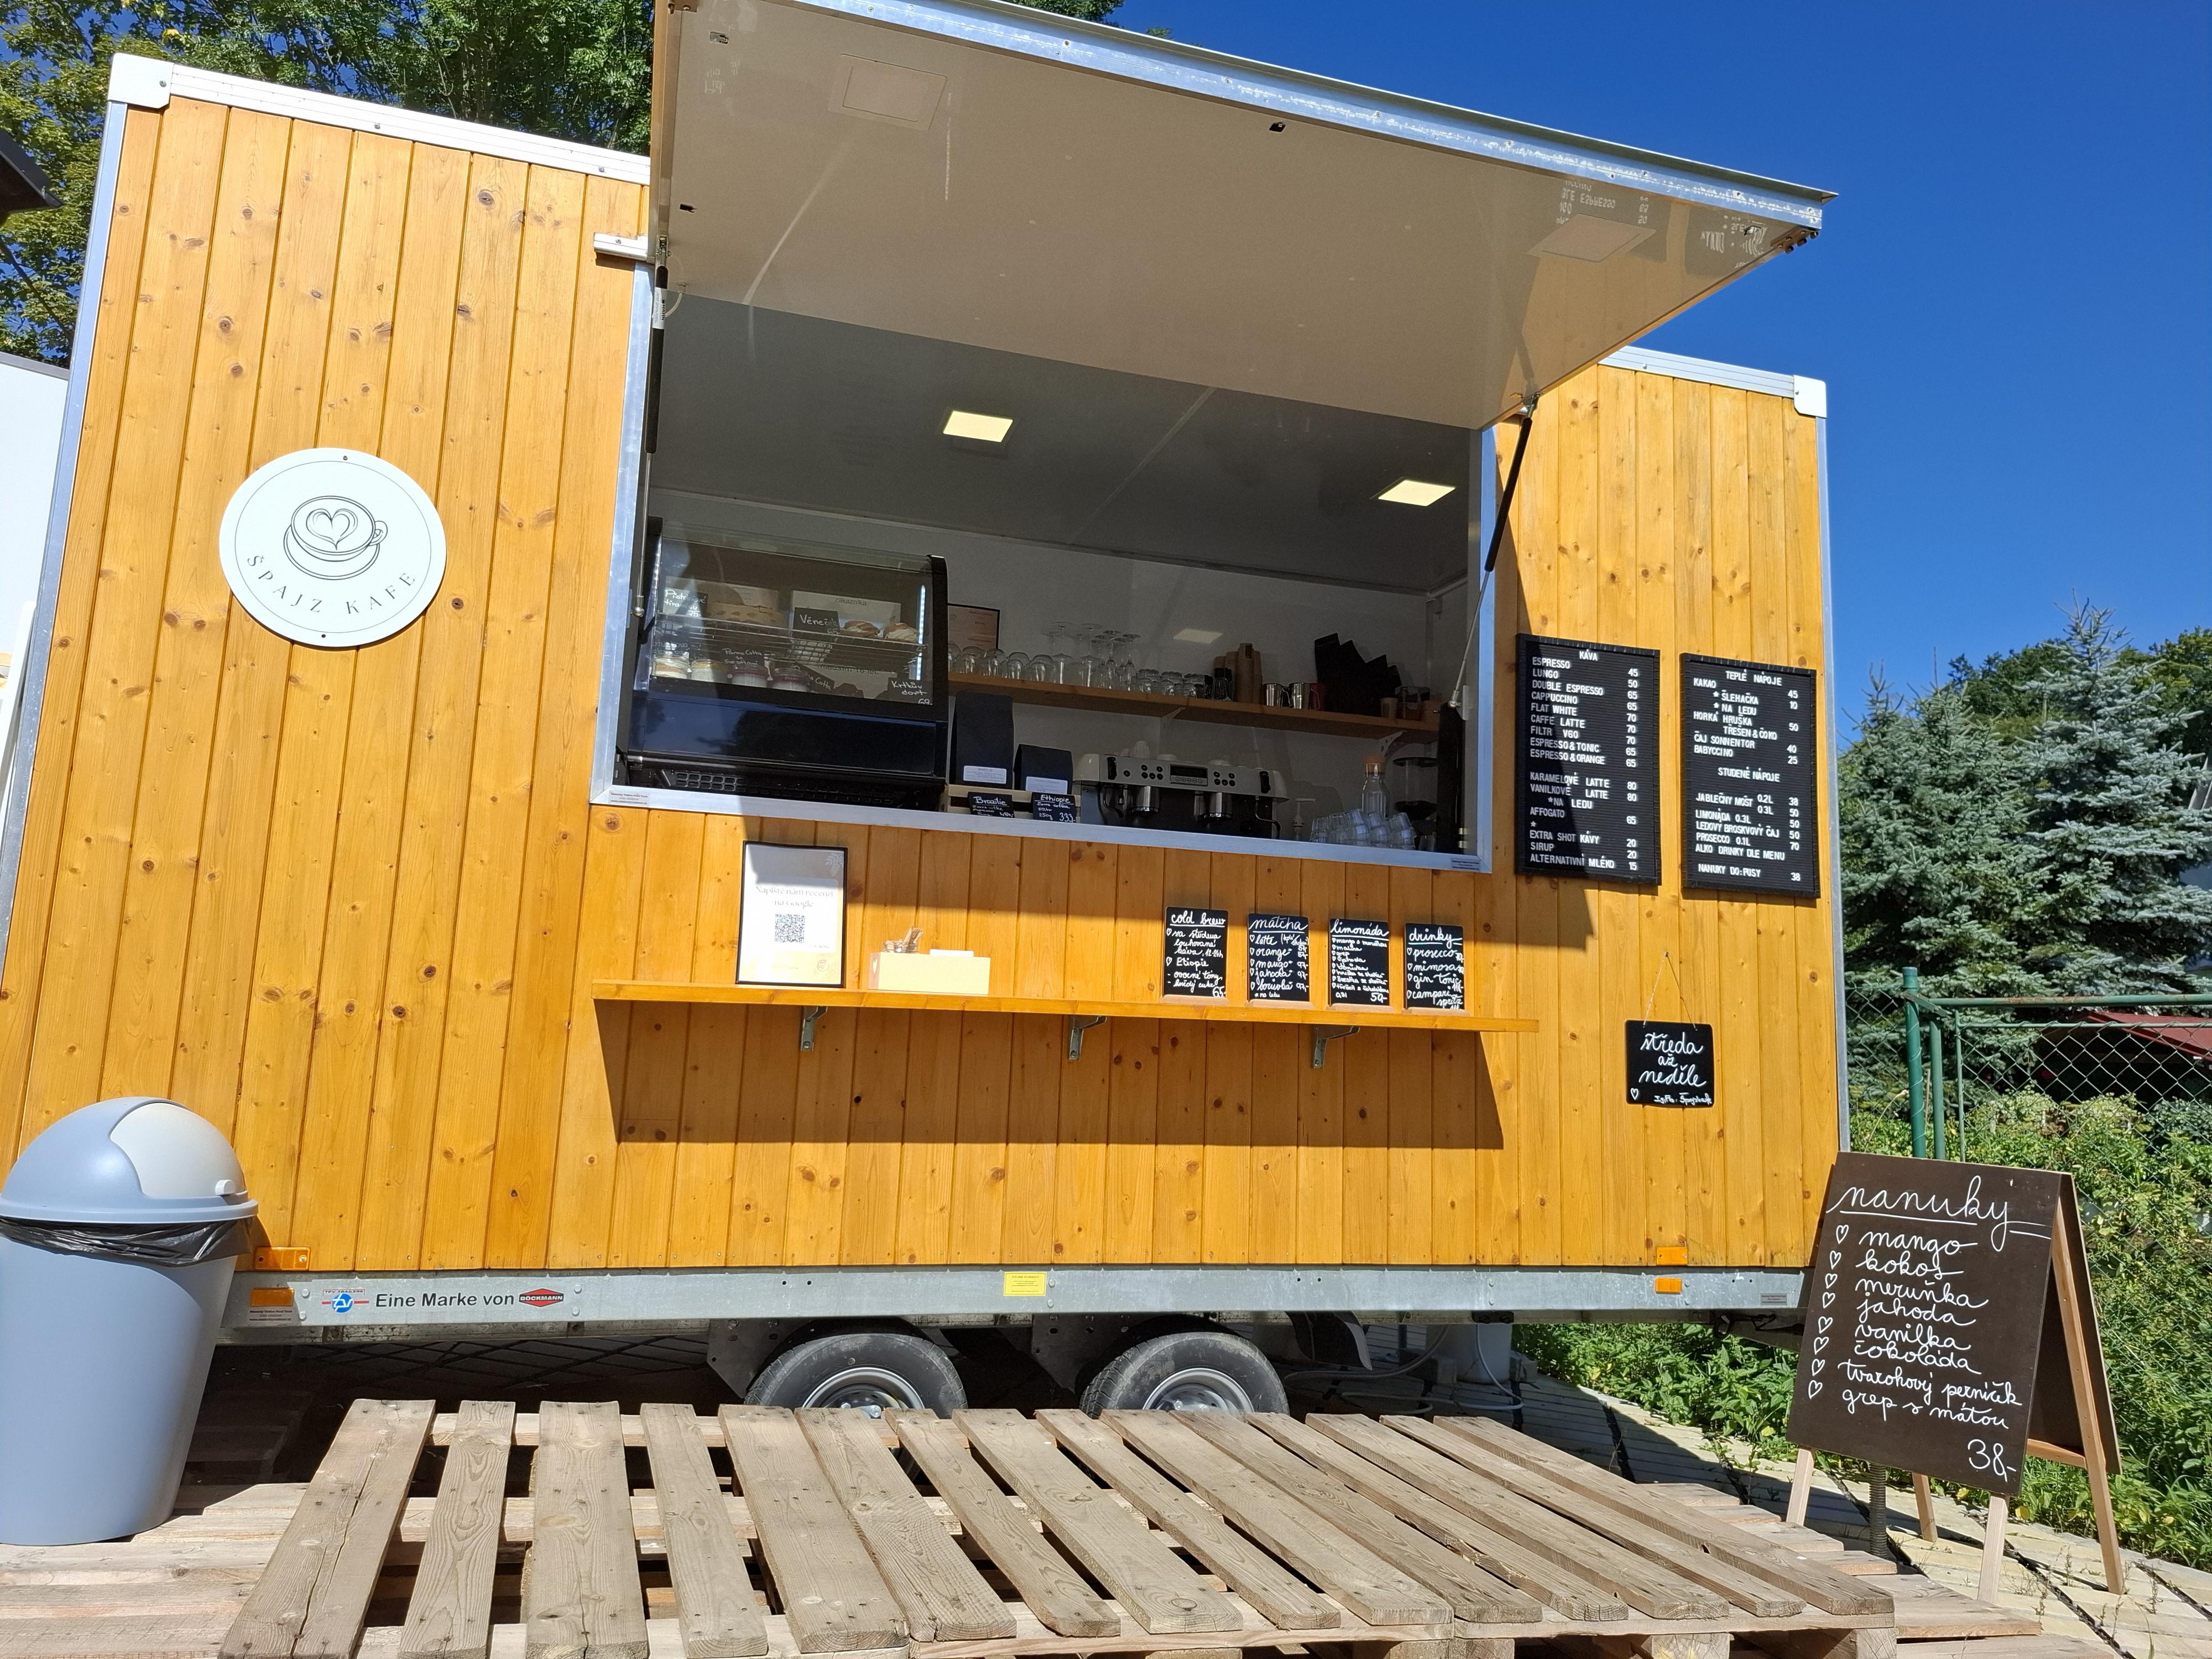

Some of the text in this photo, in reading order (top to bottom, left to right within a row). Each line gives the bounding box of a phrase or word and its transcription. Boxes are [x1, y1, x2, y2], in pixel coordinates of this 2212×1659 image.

[247, 555, 415, 614] ŠPAJZ KAFE
[1579, 649, 1598, 661] KÁVA
[1532, 657, 1638, 677] ESPRESSO 45
[1533, 669, 1638, 688] LUNGO 50
[1726, 669, 1782, 686] TEPLÉ NÁPOJE
[1532, 680, 1637, 699] DOUBLE ESPRESSO 65
[1694, 678, 1798, 699] KAKAO 45
[1531, 692, 1637, 711] CAPPUCCINO 65
[1721, 690, 1797, 709] ŠLEHAČKA 10
[1531, 703, 1636, 722] FLAT WHITE 70
[1722, 704, 1756, 715] NA LEDU
[1531, 714, 1636, 733] CAFFE LATTE 70
[1694, 711, 1798, 731] HORKÁ HRUŠKA 50
[1531, 726, 1636, 744] FILTR V60 70
[1694, 731, 1796, 753] ČAJ SONNENTOR 40
[1626, 748, 1636, 756] 65
[1694, 746, 1798, 764] BABYCCINO 25
[1626, 759, 1636, 767] 65
[1530, 772, 1636, 790] KARAMELOVÉ LATTE 80
[1718, 766, 1780, 782] STUDENÉ NÁPOJE
[1530, 784, 1636, 802] VANILKOVÉ LATTE 80
[1735, 795, 1753, 807] MOŠT
[1789, 797, 1798, 806] 38
[1571, 799, 1593, 809] LEDU
[1789, 809, 1799, 817] 50
[1530, 807, 1636, 825] AFFOGATO 65
[1696, 808, 1799, 828] LIMONÁDA 0.3L 50
[1530, 830, 1636, 847] EXTRA SHOT KÁVY 20
[1724, 824, 1763, 837] BROSKVOVÝ
[1766, 826, 1779, 837] ČAJ
[1789, 831, 1799, 839] 50
[1530, 842, 1637, 859] SIRUP 20
[1696, 833, 1799, 851] PROSECCO 0.1L 70
[1695, 844, 1785, 860] ALKO DRINKY DLE MENU
[1589, 855, 1614, 868] MLÉKO
[1629, 862, 1637, 870] 15
[1698, 864, 1726, 874] NANUKY
[1791, 873, 1800, 881] 38
[1171, 910, 1225, 925] cold brew
[1249, 916, 1308, 930] matcha
[1330, 919, 1389, 937] limonáda
[1255, 934, 1277, 945] latte
[1409, 927, 1463, 949] drinky
[1177, 958, 1209, 971] Etiopie
[1413, 949, 1457, 962] prosecco
[1174, 971, 1201, 979] ovocné
[1413, 961, 1460, 971] mimosa
[1414, 973, 1462, 989] gin tonic
[1412, 986, 1452, 1004] campari
[1640, 1032, 1703, 1054] středa
[1658, 1054, 1677, 1067] až
[1639, 1064, 1706, 1087] neděle
[1825, 1175, 2052, 1252] nanuky
[1859, 1229, 1978, 1267] mango
[1856, 1249, 1964, 1280] kokos
[375, 1294, 415, 1308] Eine
[422, 1292, 477, 1306] Marke
[483, 1294, 514, 1305] von
[1855, 1278, 1989, 1308] meruňka
[1856, 1292, 1976, 1326] jahoda
[1855, 1323, 1971, 1350] vanilka
[1854, 1340, 1982, 1375] čokoláda
[1837, 1359, 2023, 1407] tvarohový perníček
[1842, 1389, 2009, 1429] grep s mátou
[1967, 1439, 2016, 1483] 38,-
